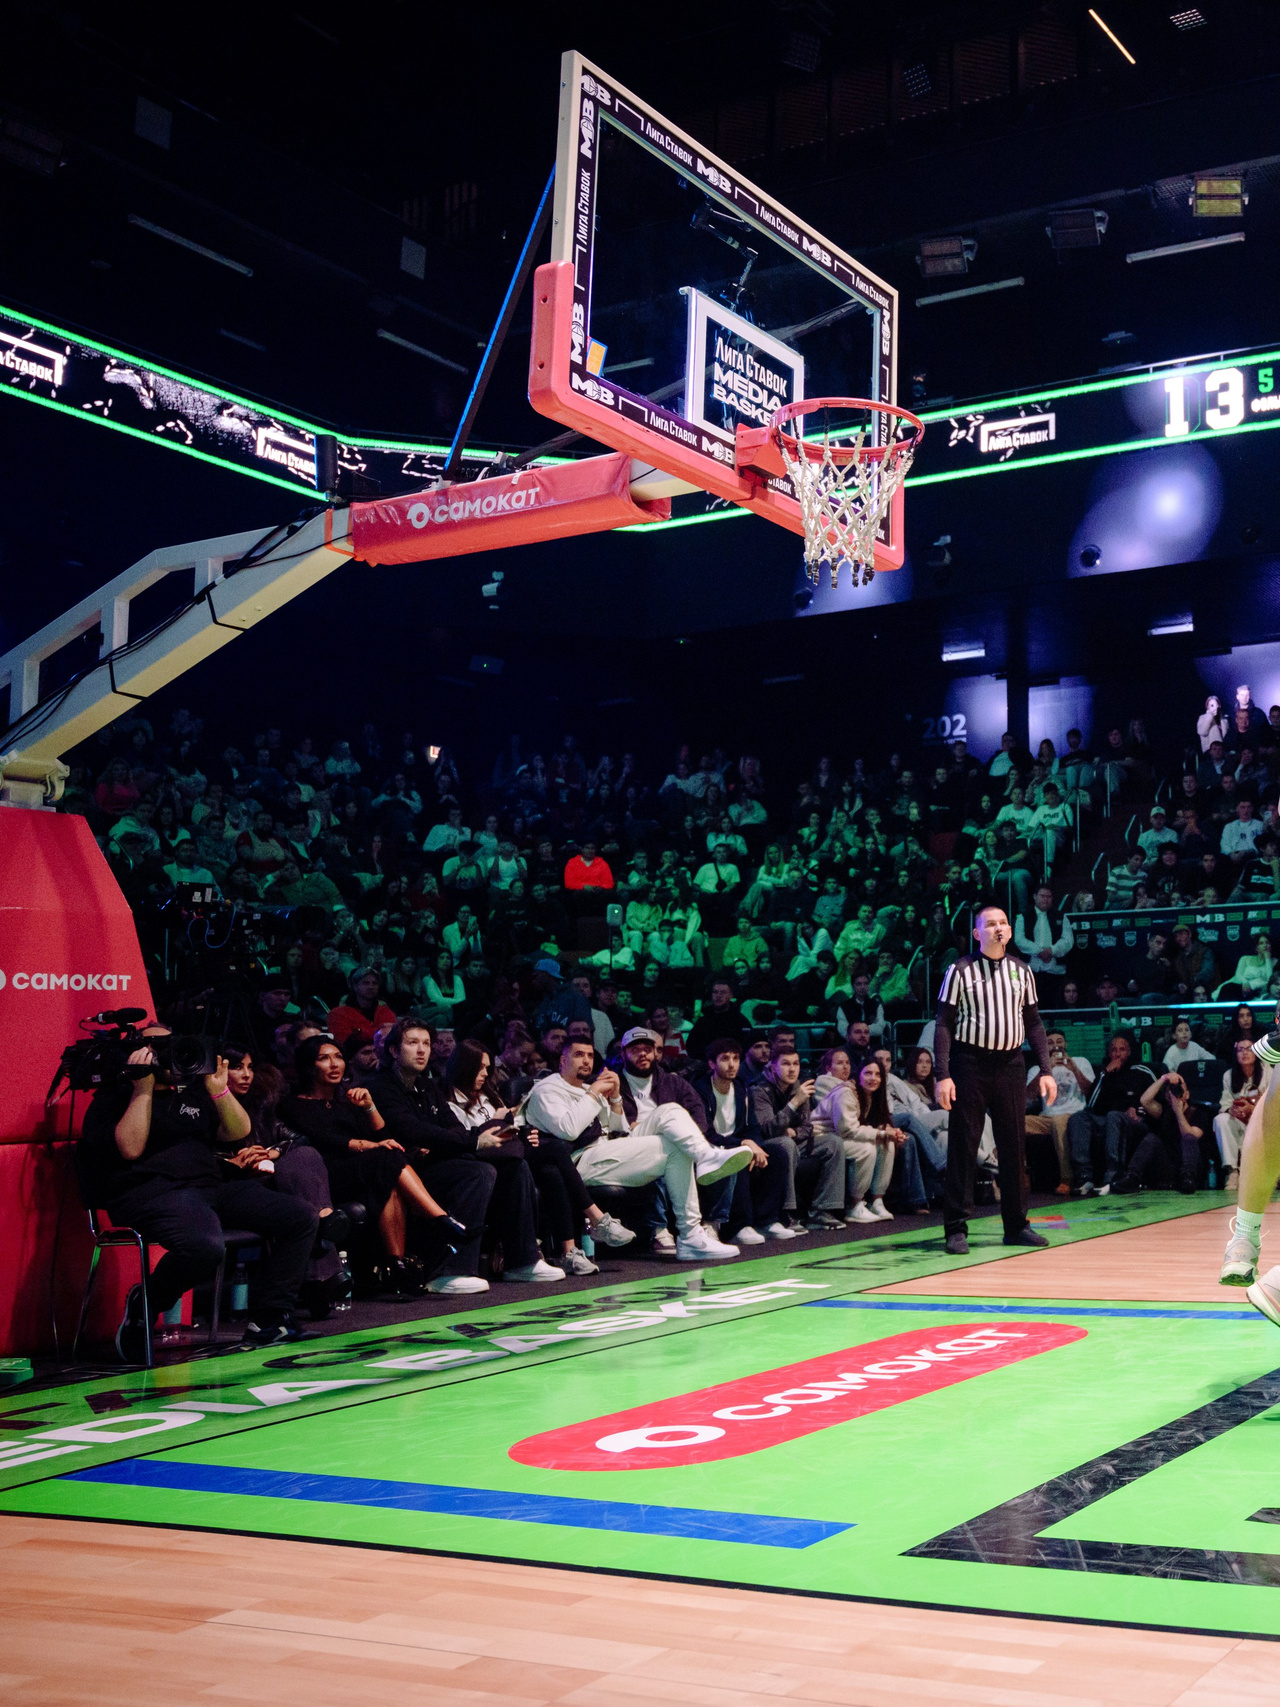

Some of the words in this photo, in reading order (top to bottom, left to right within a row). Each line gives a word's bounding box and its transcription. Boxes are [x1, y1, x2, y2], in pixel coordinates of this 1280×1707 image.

[713, 361, 782, 412] MEDIA
[715, 336, 744, 374] ЛИГА
[745, 353, 788, 398] СТАВОК
[1257, 367, 1275, 394] 5
[713, 383, 772, 428] BASKE
[1164, 367, 1245, 438] 13
[435, 486, 541, 523] самокат
[922, 713, 968, 739] 202
[11, 971, 132, 991] самокат
[366, 1278, 833, 1372] BASKET
[712, 1328, 1029, 1420] самокат
